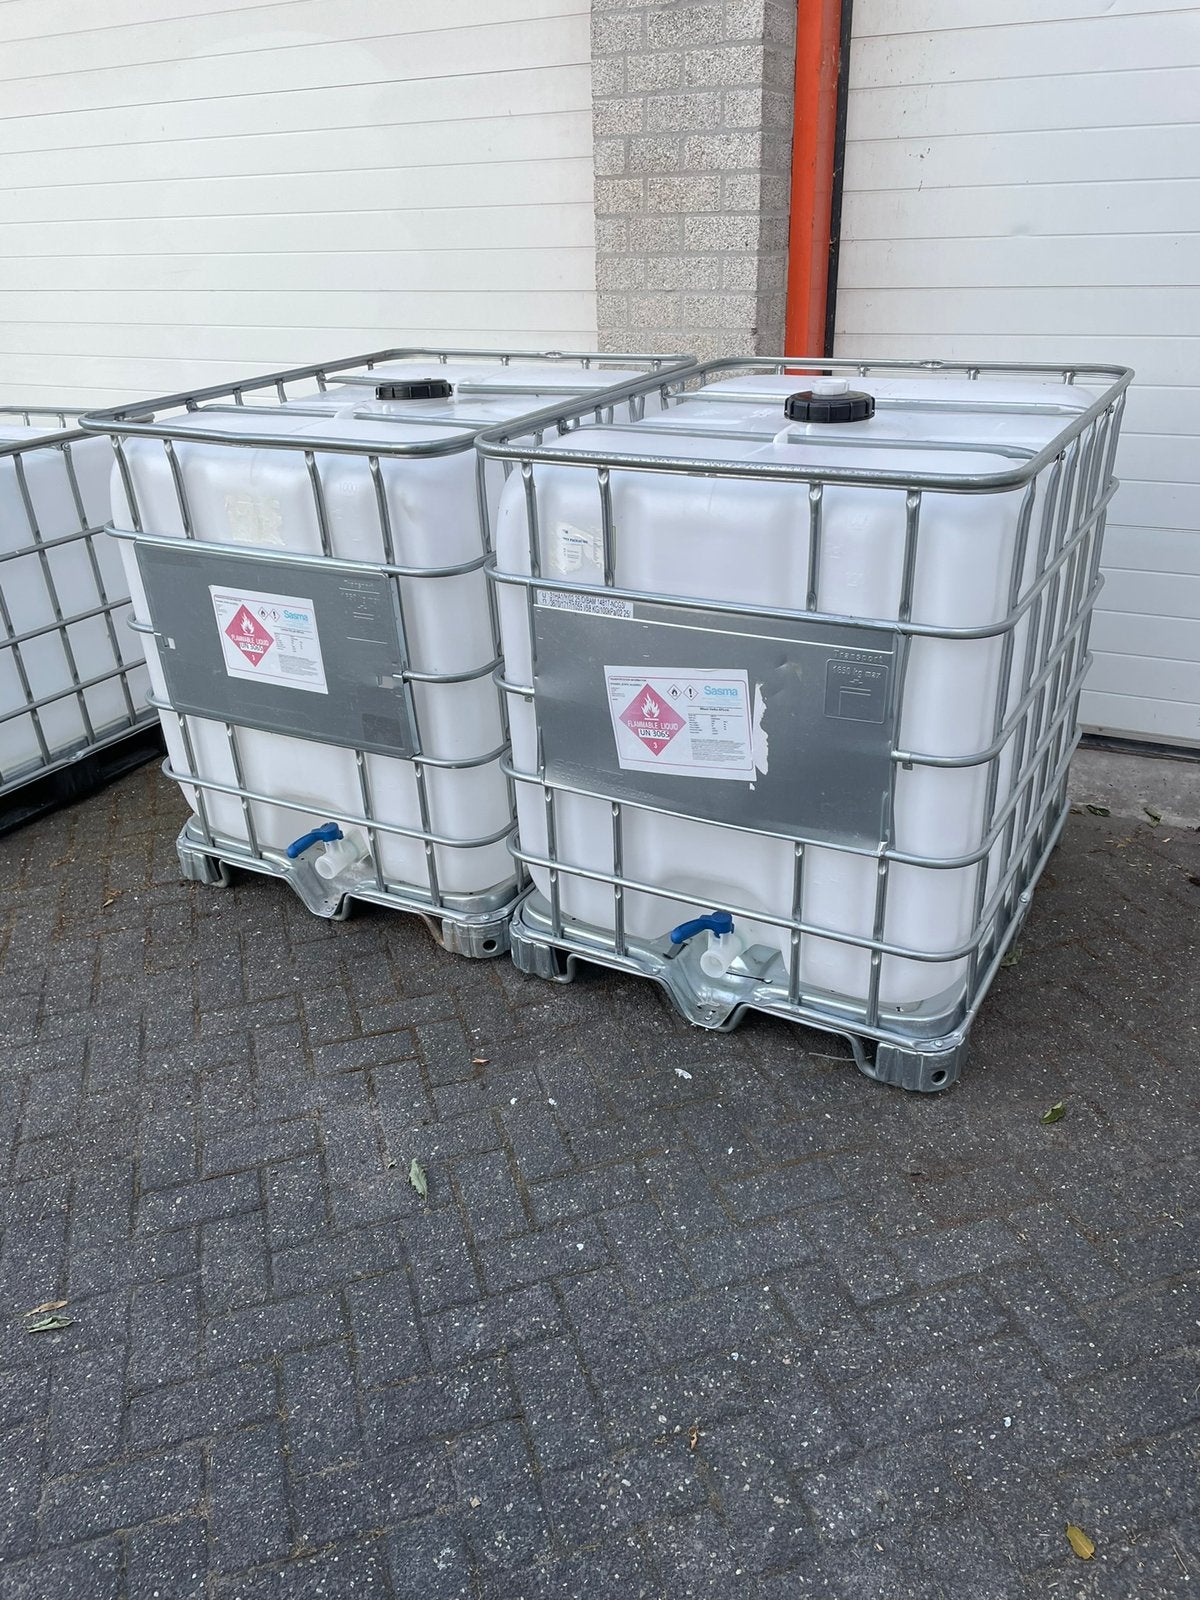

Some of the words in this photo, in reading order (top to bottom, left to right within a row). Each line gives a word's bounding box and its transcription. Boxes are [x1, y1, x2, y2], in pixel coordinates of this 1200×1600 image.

[283, 609, 309, 621] Sasma
[704, 685, 738, 696] Sasma
[627, 720, 658, 729] FLAMMABLE
[660, 723, 679, 731] LIQUID
[640, 729, 651, 737] UN
[652, 730, 670, 738] 3065
